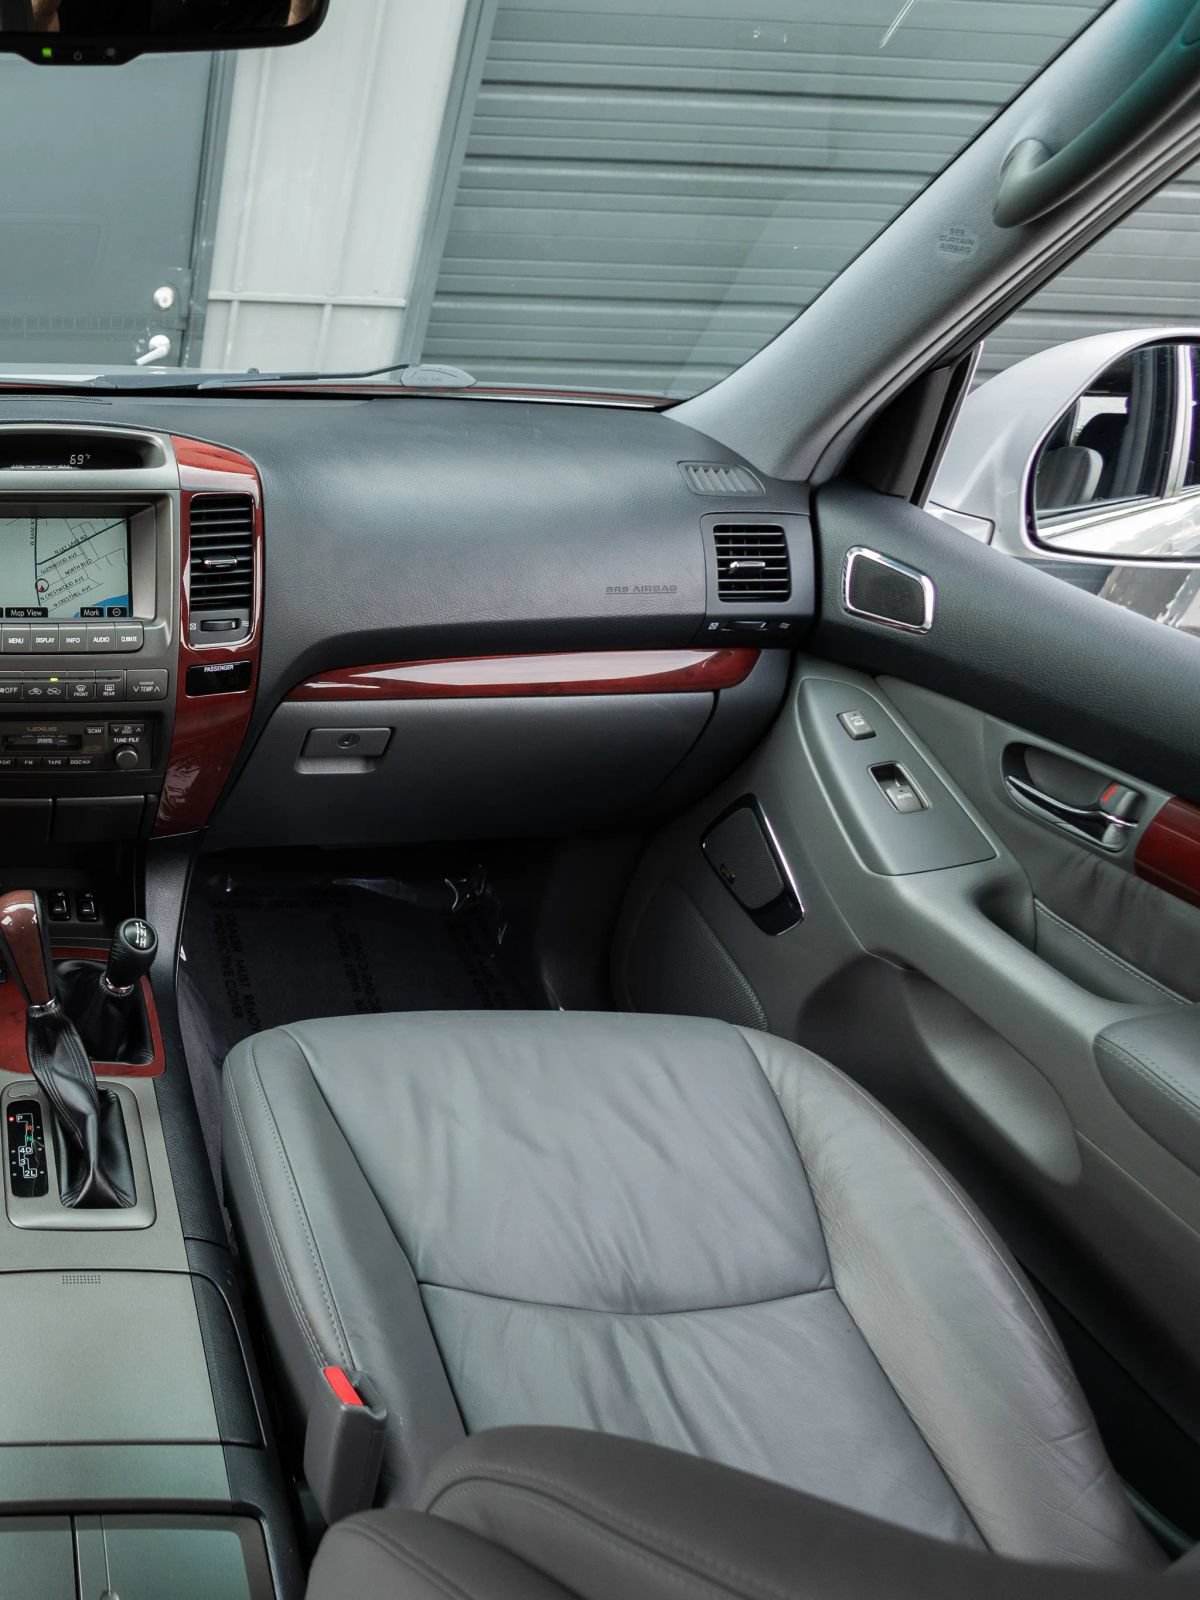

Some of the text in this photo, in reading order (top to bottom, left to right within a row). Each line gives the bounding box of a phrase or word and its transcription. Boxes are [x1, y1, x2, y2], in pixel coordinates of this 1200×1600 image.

[40, 558, 68, 574] GLENWOOD
[64, 558, 92, 576] NORTH BLVD
[45, 582, 74, 598] CRESTWOOD
[10, 608, 42, 618] Map View
[204, 664, 234, 672] PASSENGER
[236, 958, 251, 988] MUST
[225, 980, 244, 1019] COVER
